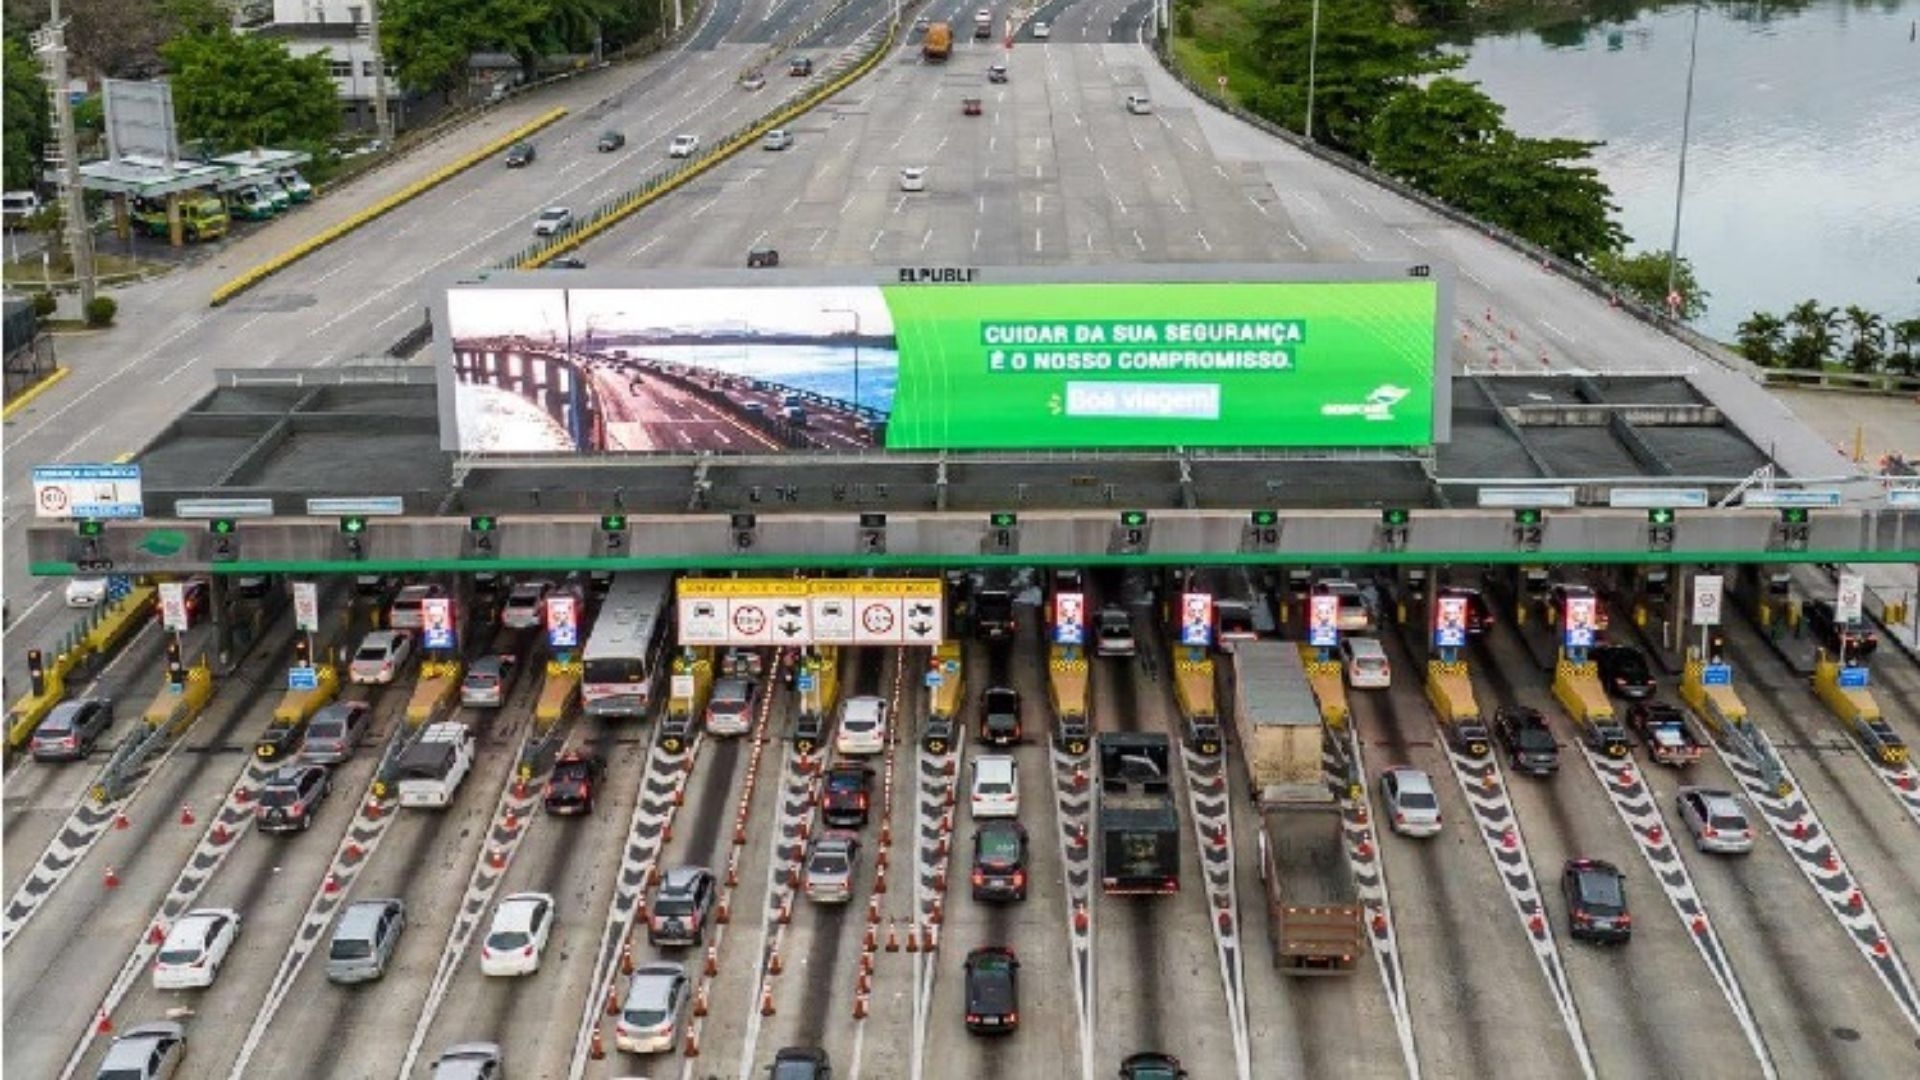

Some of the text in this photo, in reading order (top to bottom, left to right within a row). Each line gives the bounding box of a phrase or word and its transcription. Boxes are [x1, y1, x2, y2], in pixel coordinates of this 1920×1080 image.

[984, 322, 1301, 346] CUIDAR DA SUA SEGURANÇA
[1011, 352, 1028, 370] O
[1033, 352, 1112, 370] NOSSO
[1118, 351, 1293, 370] COMPROMISSO.
[1071, 386, 1218, 415] Boa viagem!
[608, 533, 621, 549] 5
[737, 531, 750, 549] 6
[1128, 530, 1143, 546] 9
[1252, 529, 1277, 545] 10
[1384, 528, 1409, 544] 11
[1513, 527, 1541, 543] 12
[1649, 527, 1674, 544] 13
[1779, 526, 1807, 541] 14
[216, 538, 229, 554] 2
[348, 537, 362, 553] 3
[481, 535, 494, 551] 4
